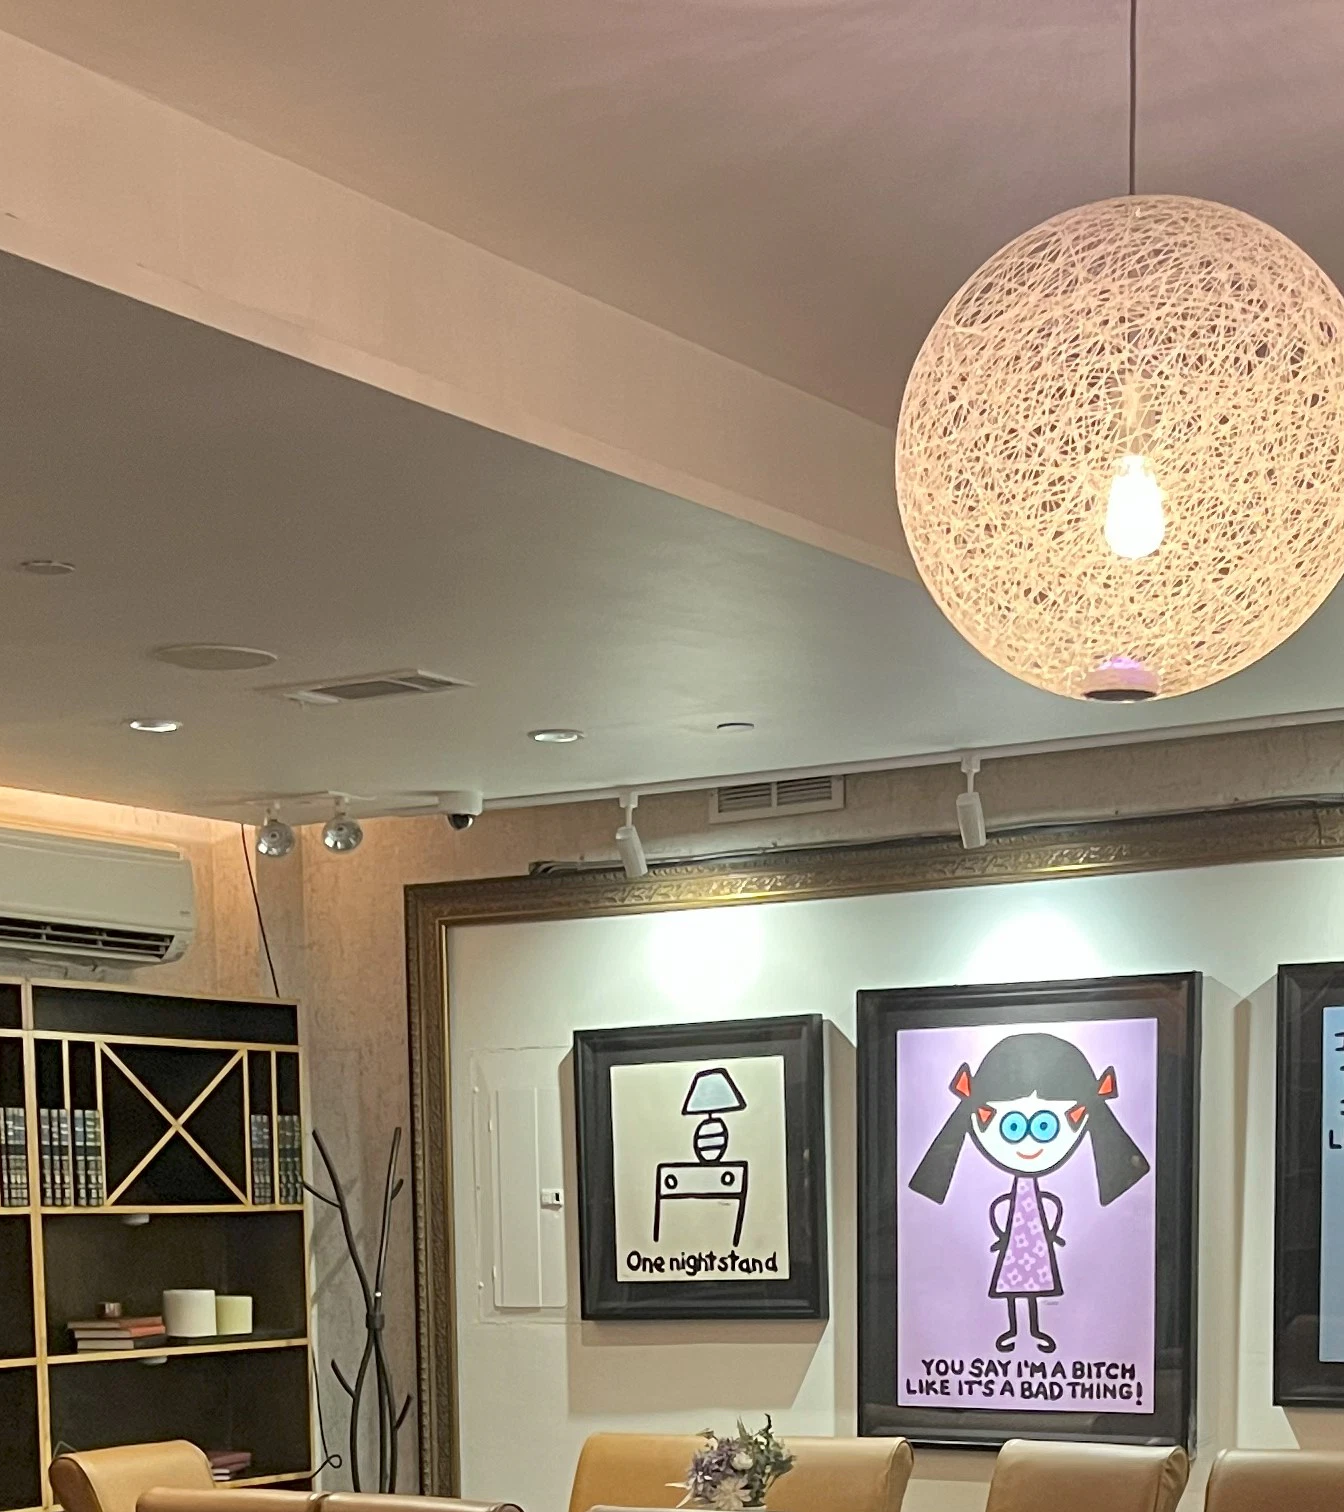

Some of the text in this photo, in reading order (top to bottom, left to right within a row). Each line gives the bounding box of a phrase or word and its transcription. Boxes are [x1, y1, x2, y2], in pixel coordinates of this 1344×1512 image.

[626, 1250, 665, 1273] One
[921, 1358, 1136, 1381] YOU SAY I'M A BITCH
[906, 1378, 951, 1396] LIKE
[999, 1380, 1015, 1398] A
[1020, 1381, 1064, 1401] BAD
[1066, 1381, 1143, 1406] THING!
